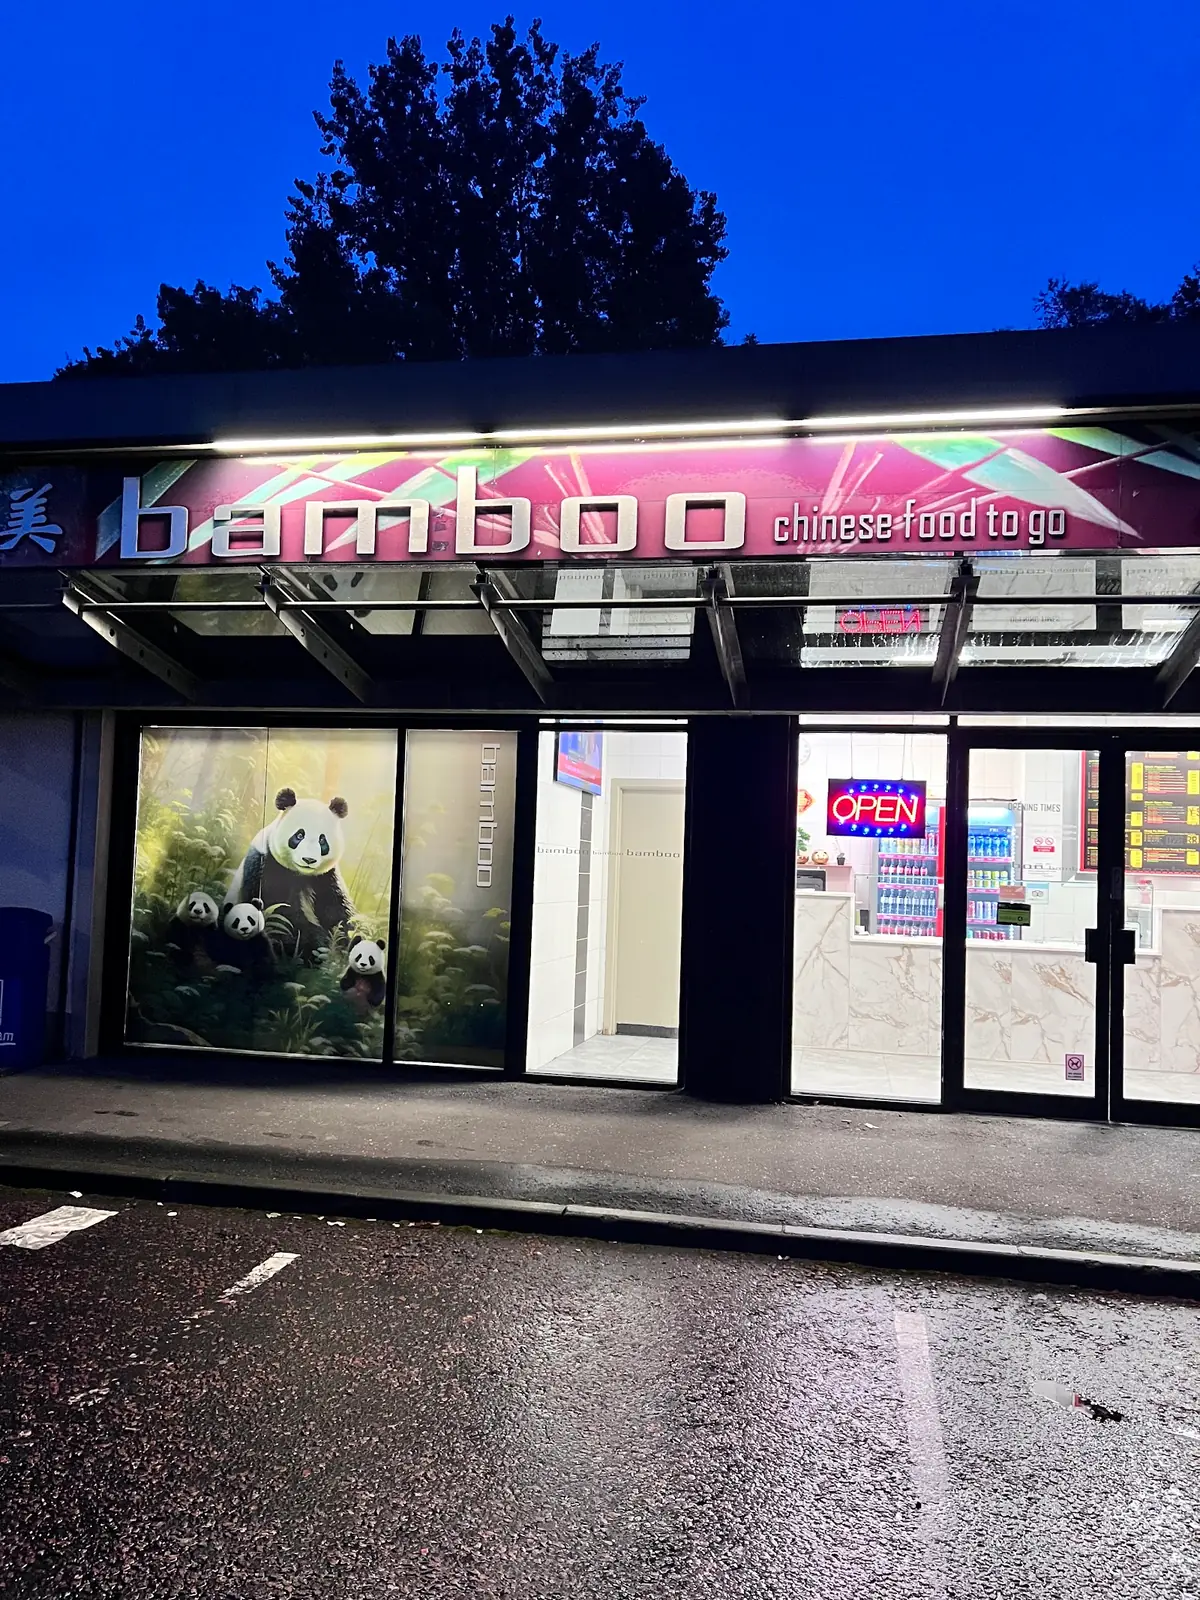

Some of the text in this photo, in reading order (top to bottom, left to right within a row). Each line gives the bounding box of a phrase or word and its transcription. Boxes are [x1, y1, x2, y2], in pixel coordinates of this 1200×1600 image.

[0, 483, 63, 554] 美
[119, 465, 747, 561] bamboo
[773, 498, 1066, 544] chinese food to go
[476, 743, 501, 888] bamboo
[832, 794, 919, 823] OPEN
[1007, 802, 1061, 812] OPENING TIMES
[537, 846, 589, 855] bamboo
[626, 849, 680, 858] bamboo
